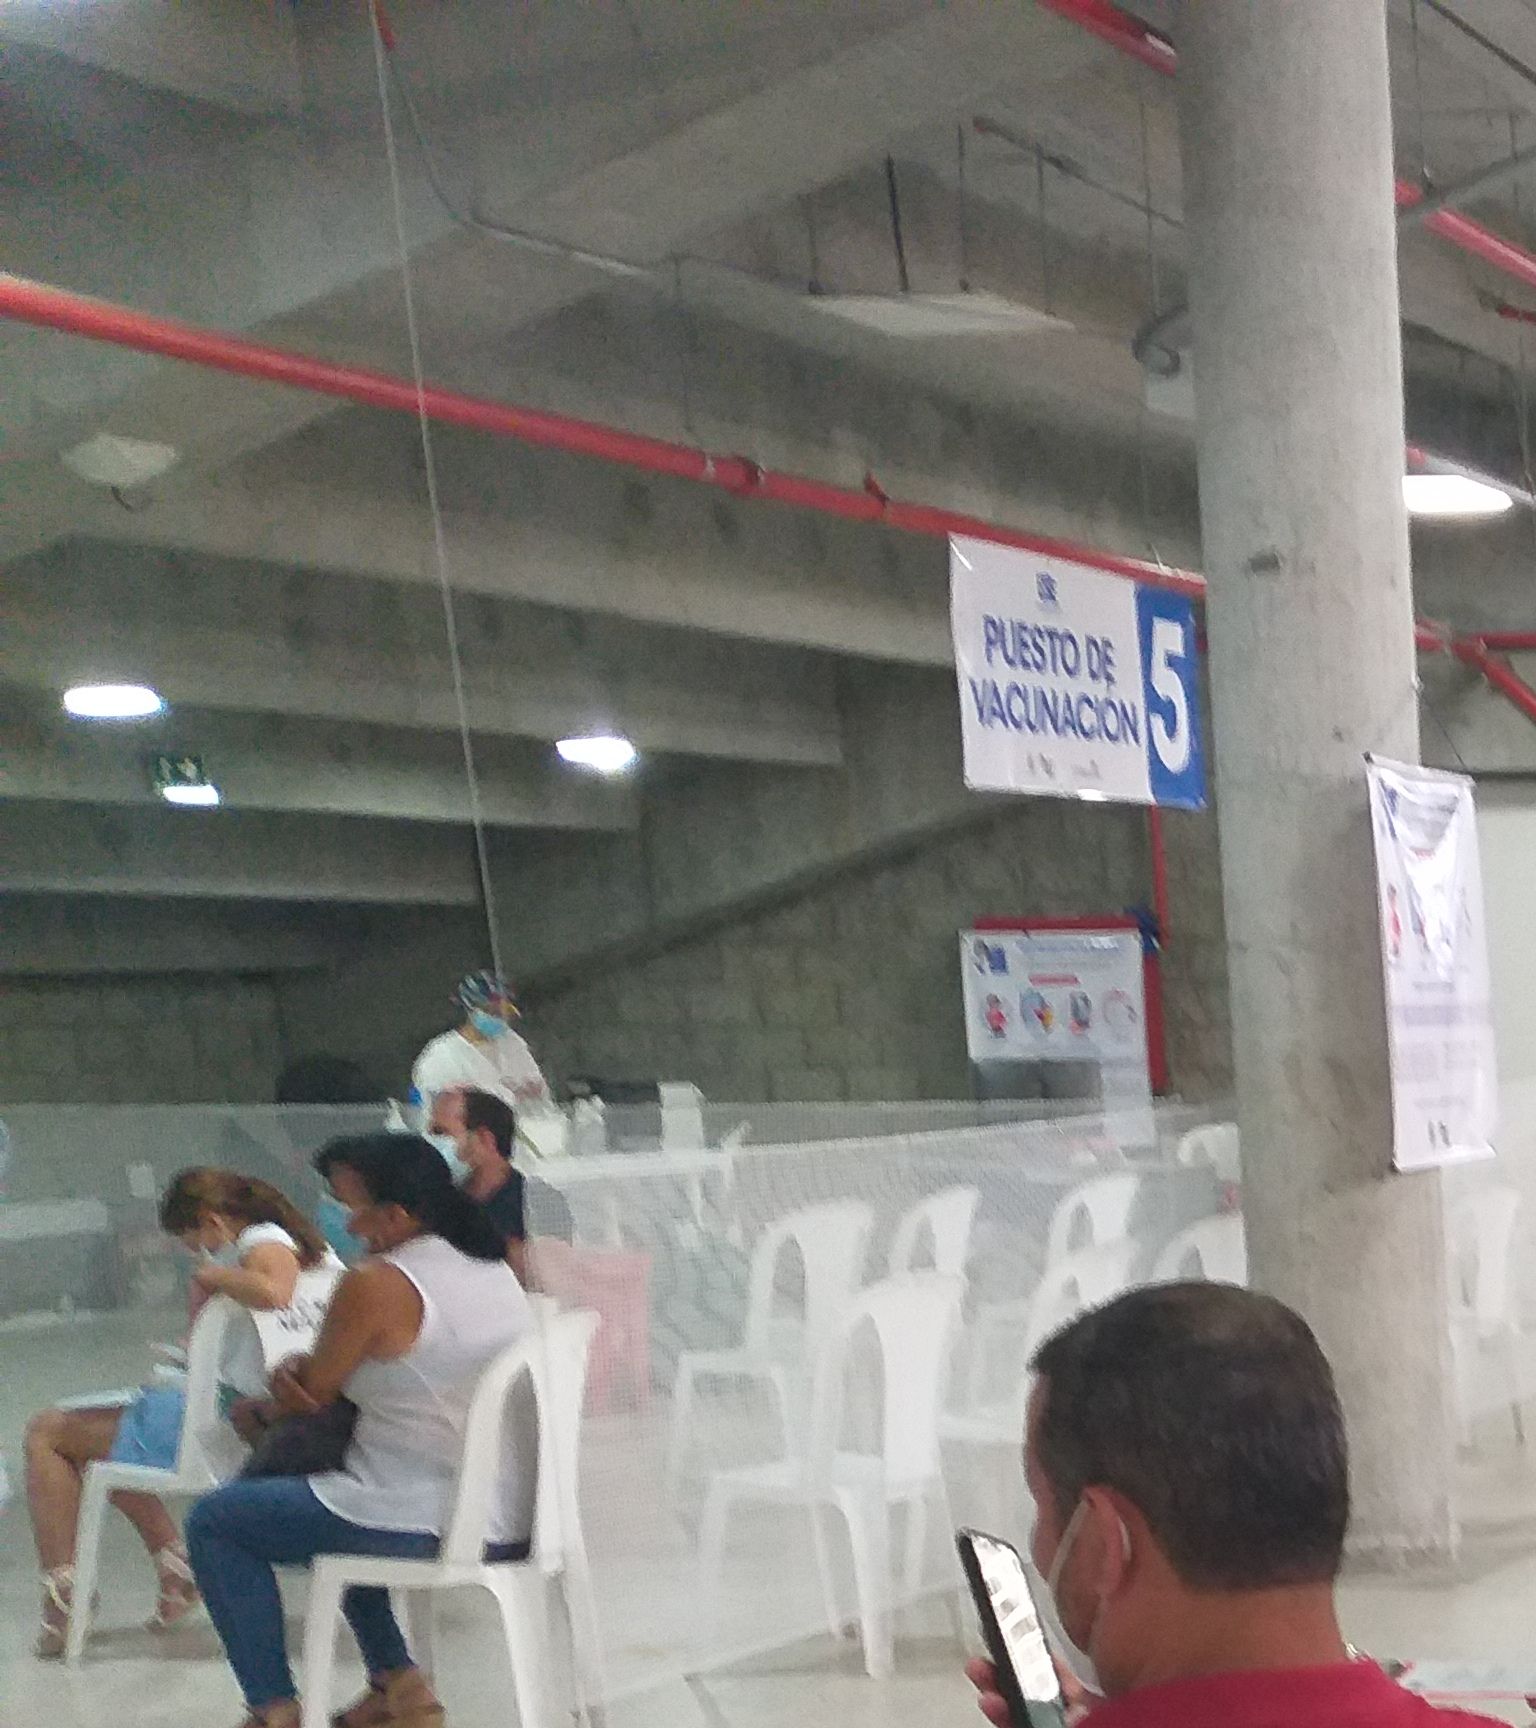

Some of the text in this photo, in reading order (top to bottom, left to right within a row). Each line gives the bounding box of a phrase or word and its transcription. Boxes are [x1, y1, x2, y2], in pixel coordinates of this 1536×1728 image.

[982, 614, 1116, 684] PUESTO DE
[1150, 617, 1190, 775] 5
